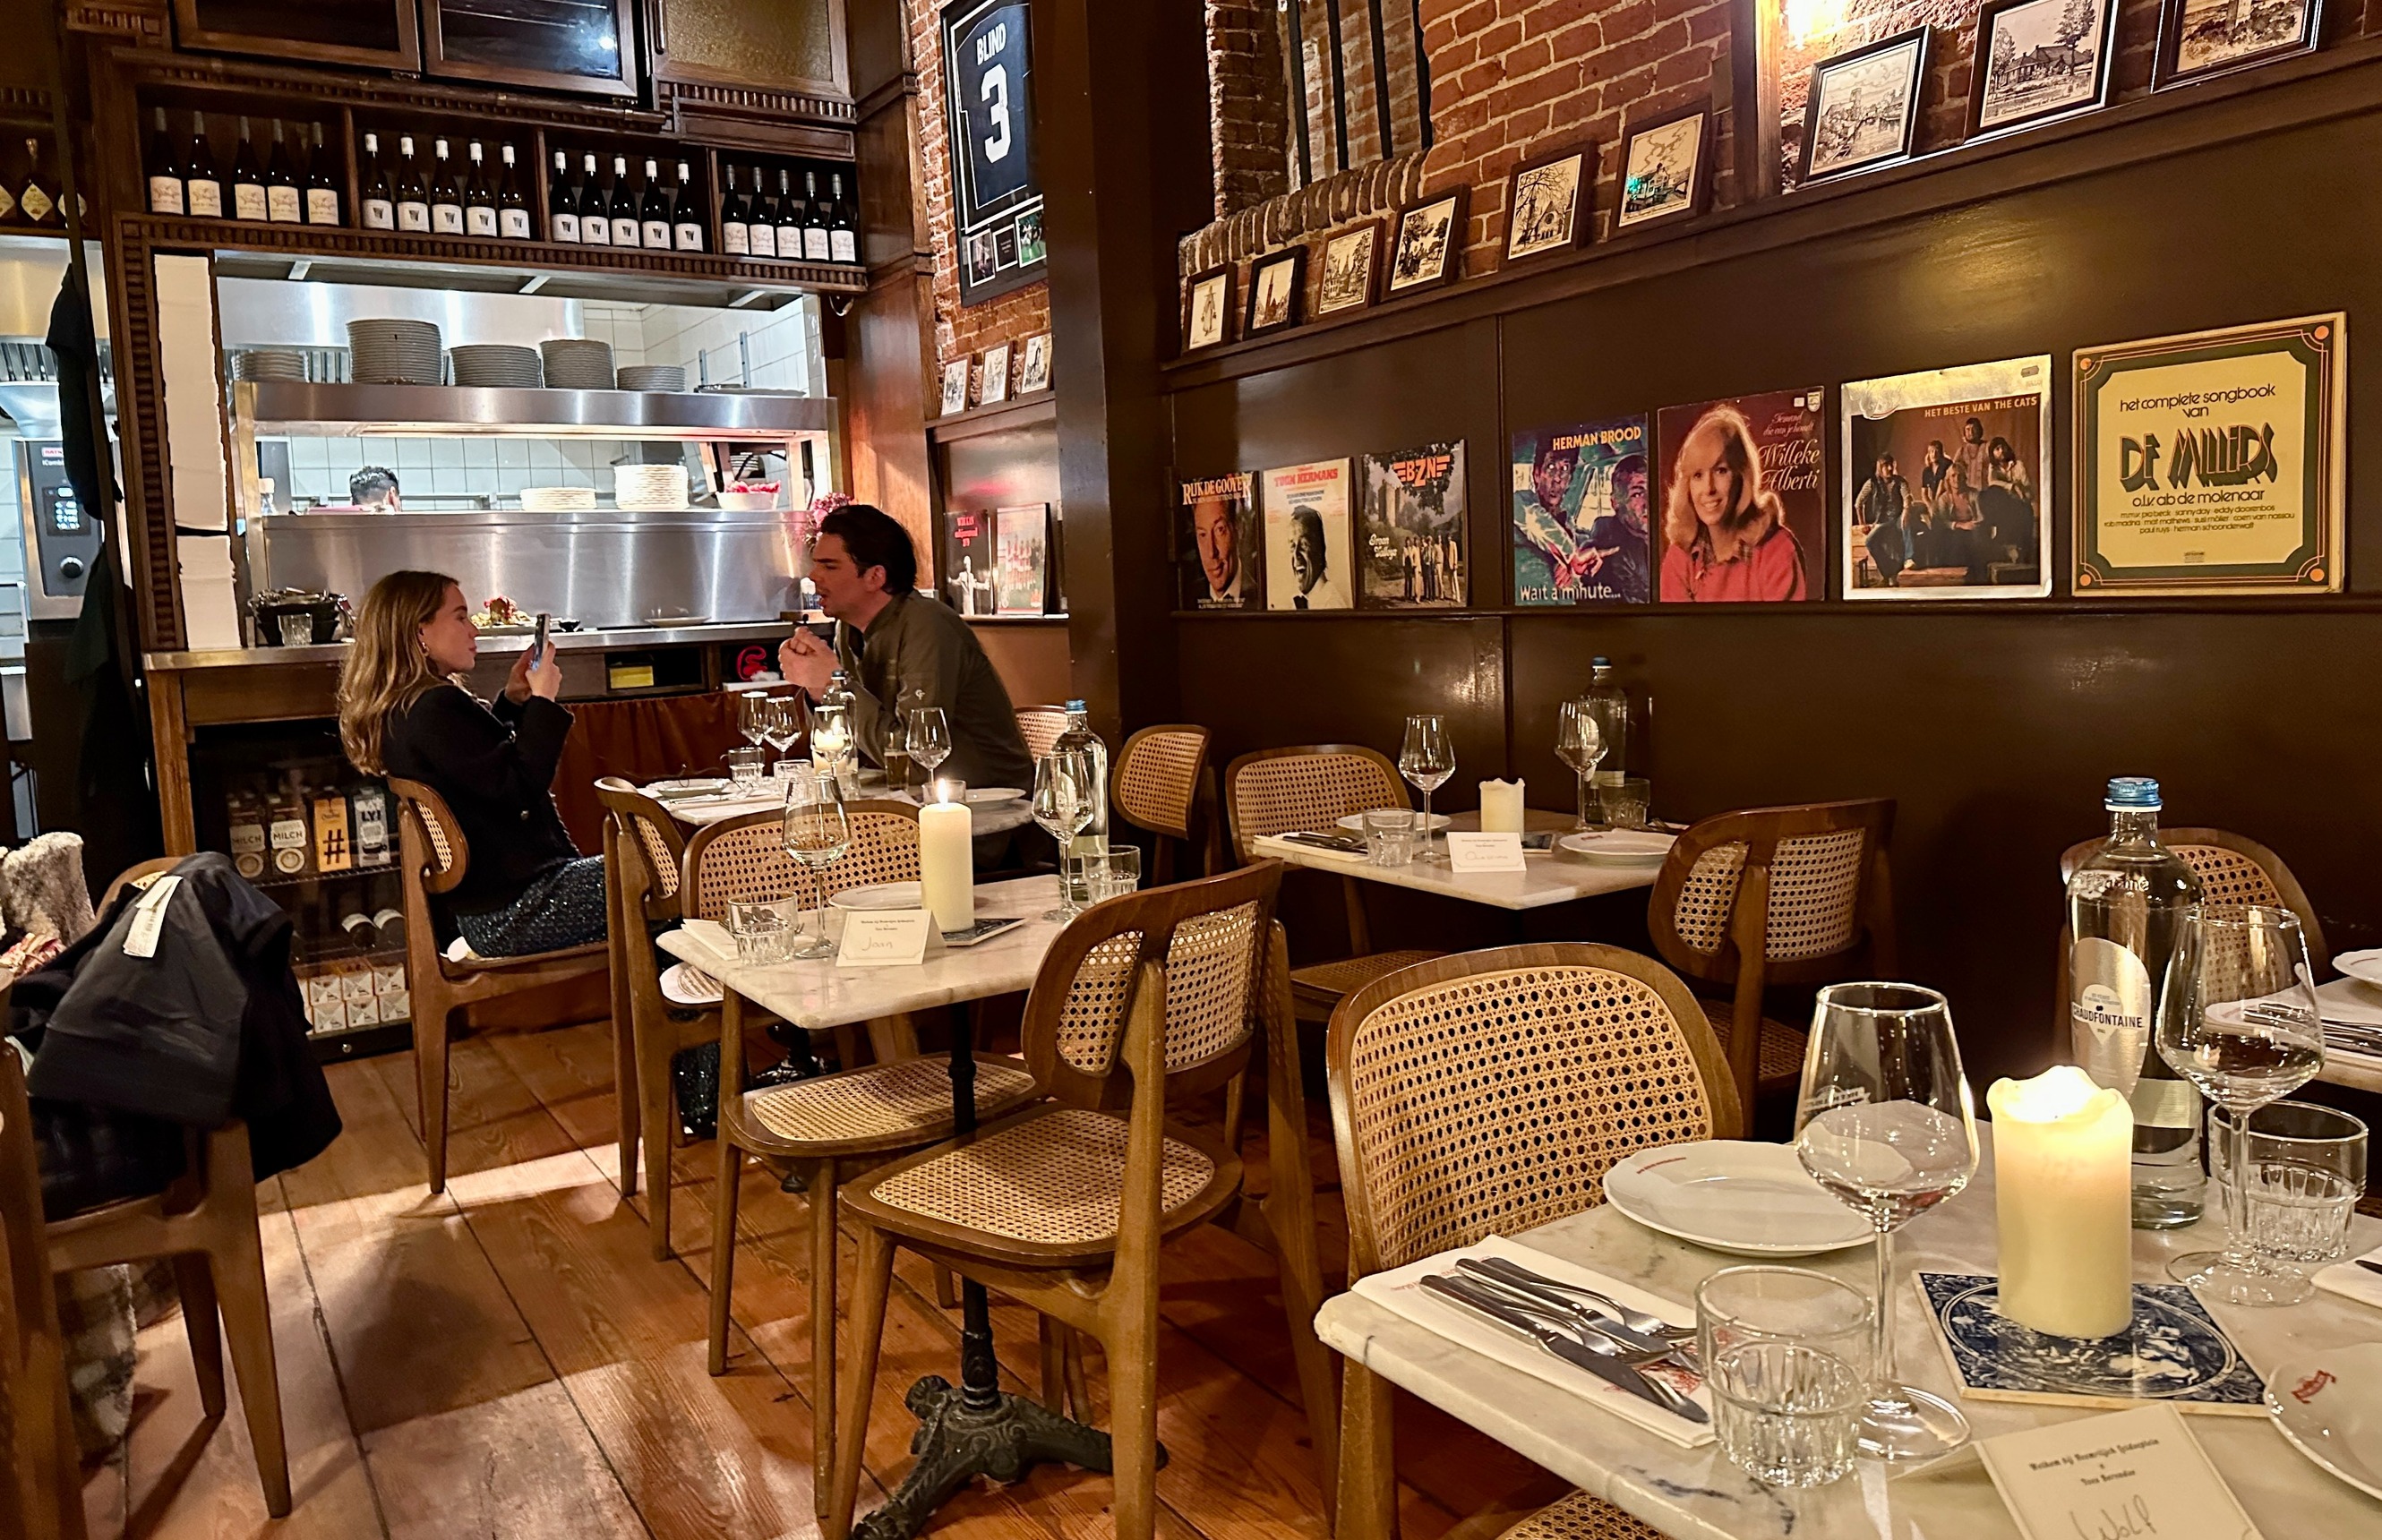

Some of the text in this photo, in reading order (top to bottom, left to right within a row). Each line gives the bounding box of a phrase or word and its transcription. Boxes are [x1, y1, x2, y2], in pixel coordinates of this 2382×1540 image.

[976, 22, 1007, 66] BLIND
[981, 63, 1012, 164] 3
[1924, 396, 2038, 418] HET BESTE VAN THE CATS
[2120, 383, 2276, 413] het complete songbook
[2182, 406, 2209, 418] van
[1553, 426, 1641, 451] HERMAN BROOD
[1758, 439, 1821, 468] Willeke
[2119, 422, 2279, 493] DE MILLERS
[1297, 467, 1339, 484] HERMANS
[1404, 456, 1438, 488] BZN
[1761, 466, 1821, 492] Alberti
[2156, 493, 2176, 508] ab
[2177, 492, 2195, 504] de
[2197, 489, 2266, 504] molenaar
[1520, 584, 1548, 602] Wait
[1552, 586, 1559, 601] a
[273, 831, 304, 842] MILCH
[2072, 1004, 2144, 1028] CHAUDFONTAINE
